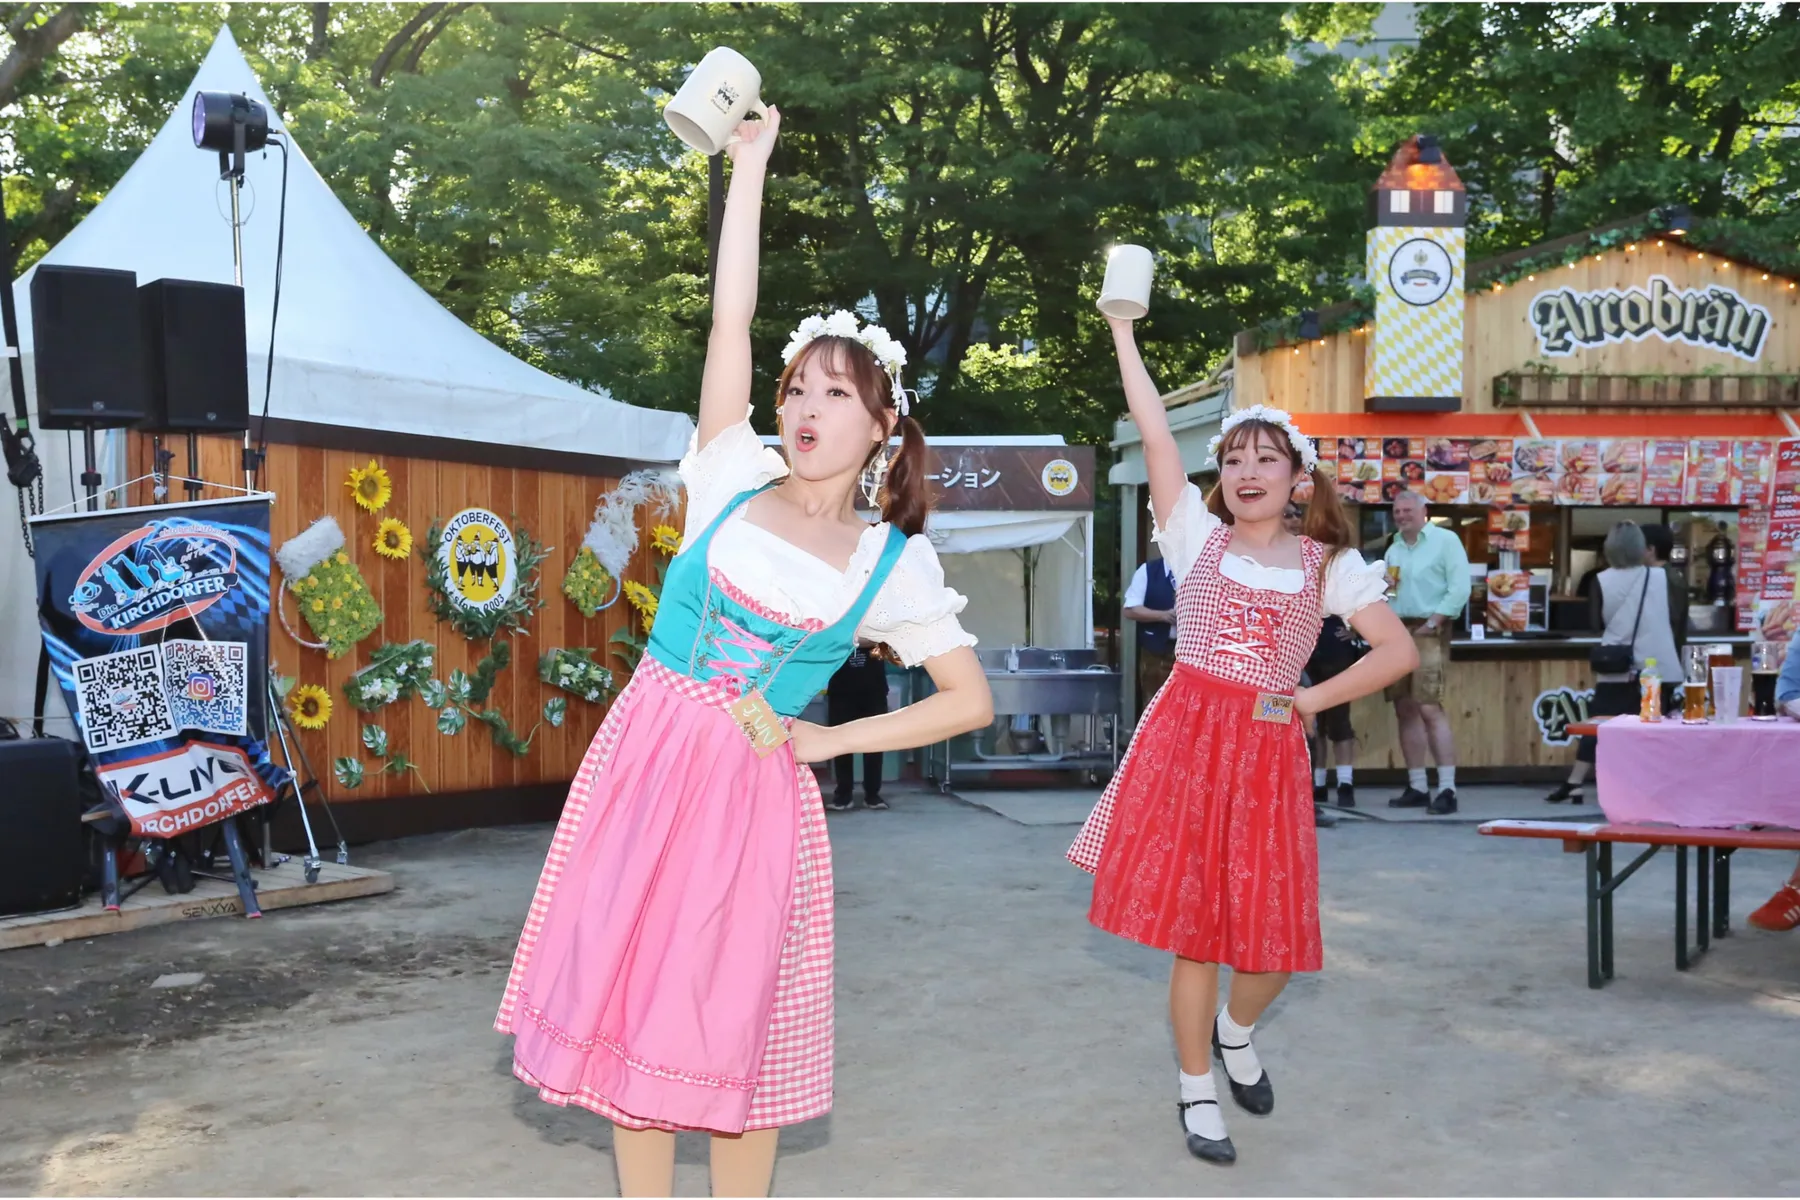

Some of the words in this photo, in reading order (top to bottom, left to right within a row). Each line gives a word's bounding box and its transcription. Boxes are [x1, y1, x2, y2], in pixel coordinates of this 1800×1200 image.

[1533, 277, 1766, 358] Arcobräu
[924, 467, 1001, 488] ーション
[444, 512, 511, 544] OKTOBERFEST
[99, 603, 118, 618] Die
[110, 576, 228, 630] KIRCHDORFER
[742, 703, 778, 745] JUN
